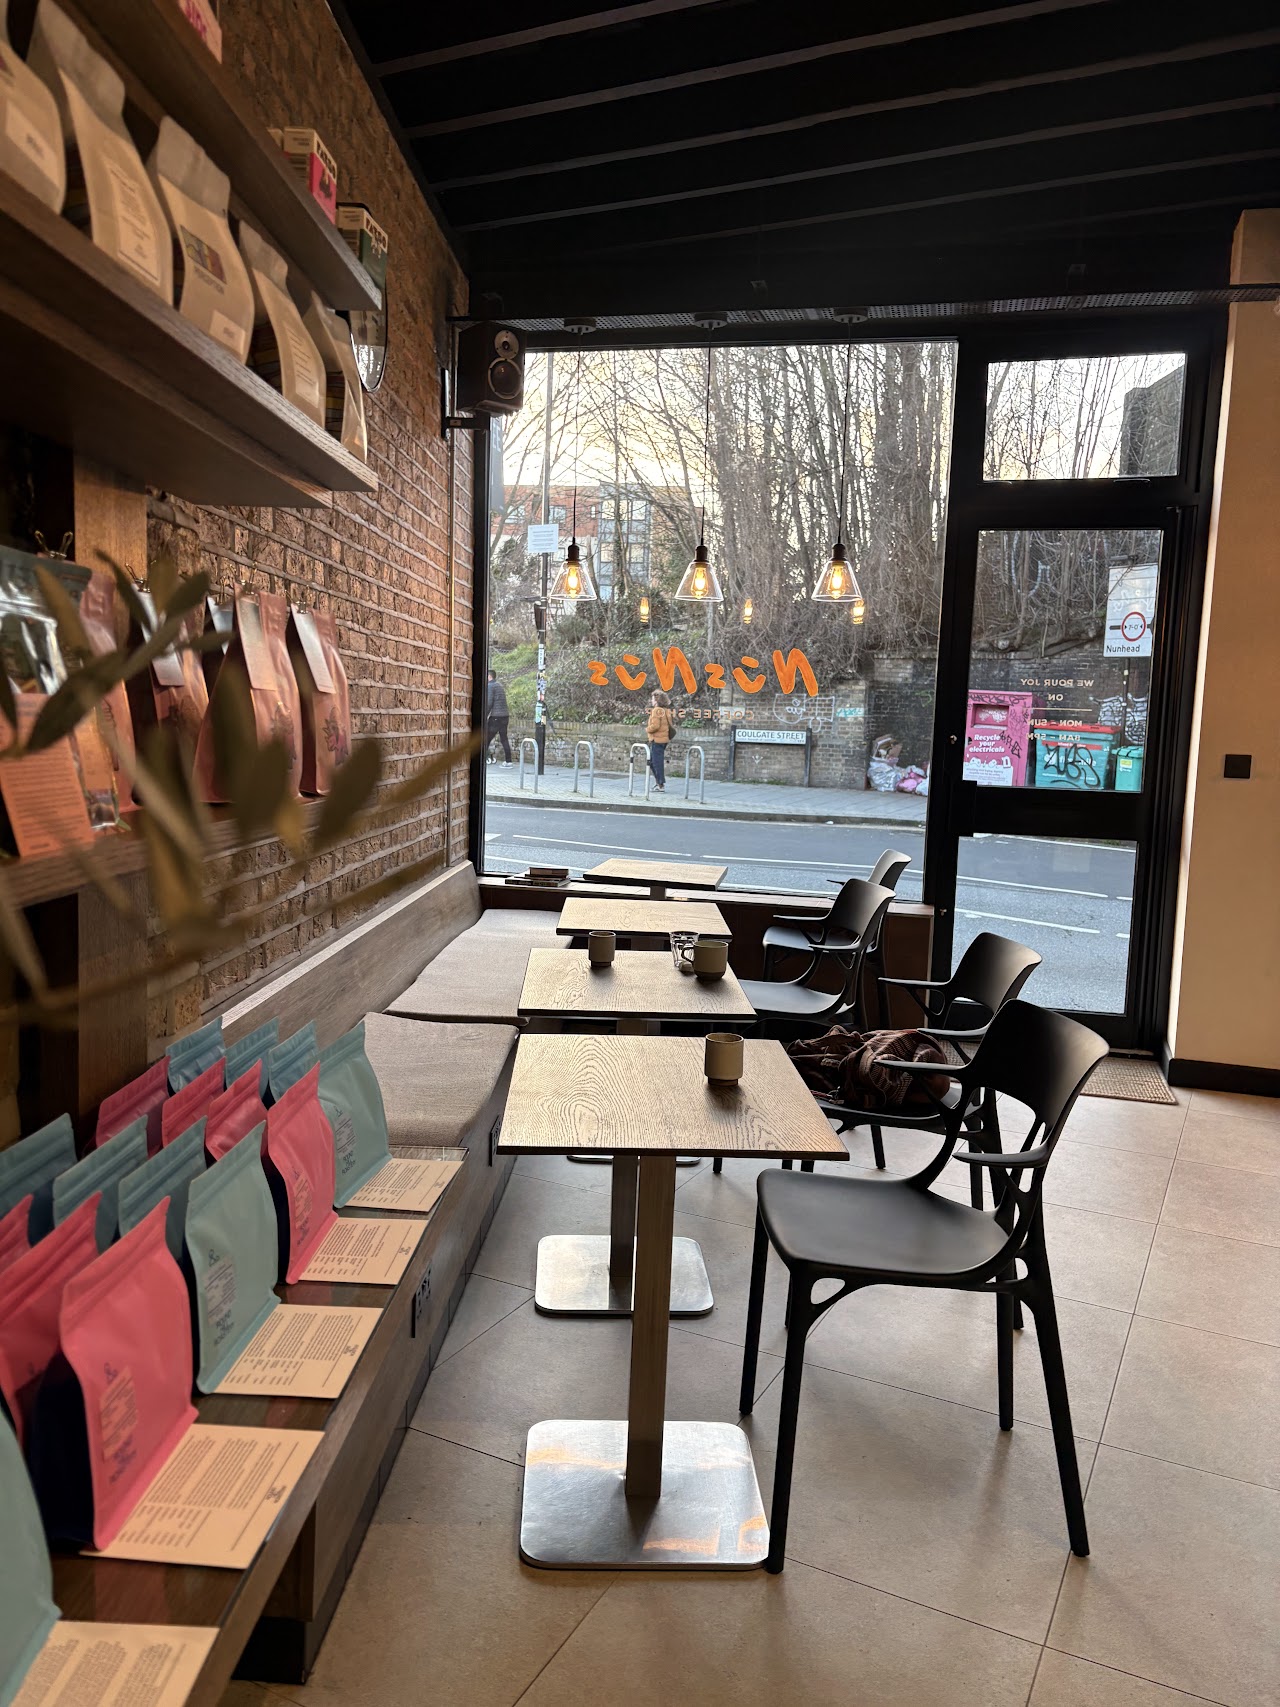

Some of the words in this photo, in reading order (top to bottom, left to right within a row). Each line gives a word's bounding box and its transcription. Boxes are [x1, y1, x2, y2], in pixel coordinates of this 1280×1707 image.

[1106, 644, 1141, 654] Nunhead
[737, 731, 775, 739] COULGATE
[776, 732, 805, 740] STREET
[974, 734, 1001, 742] Recycle
